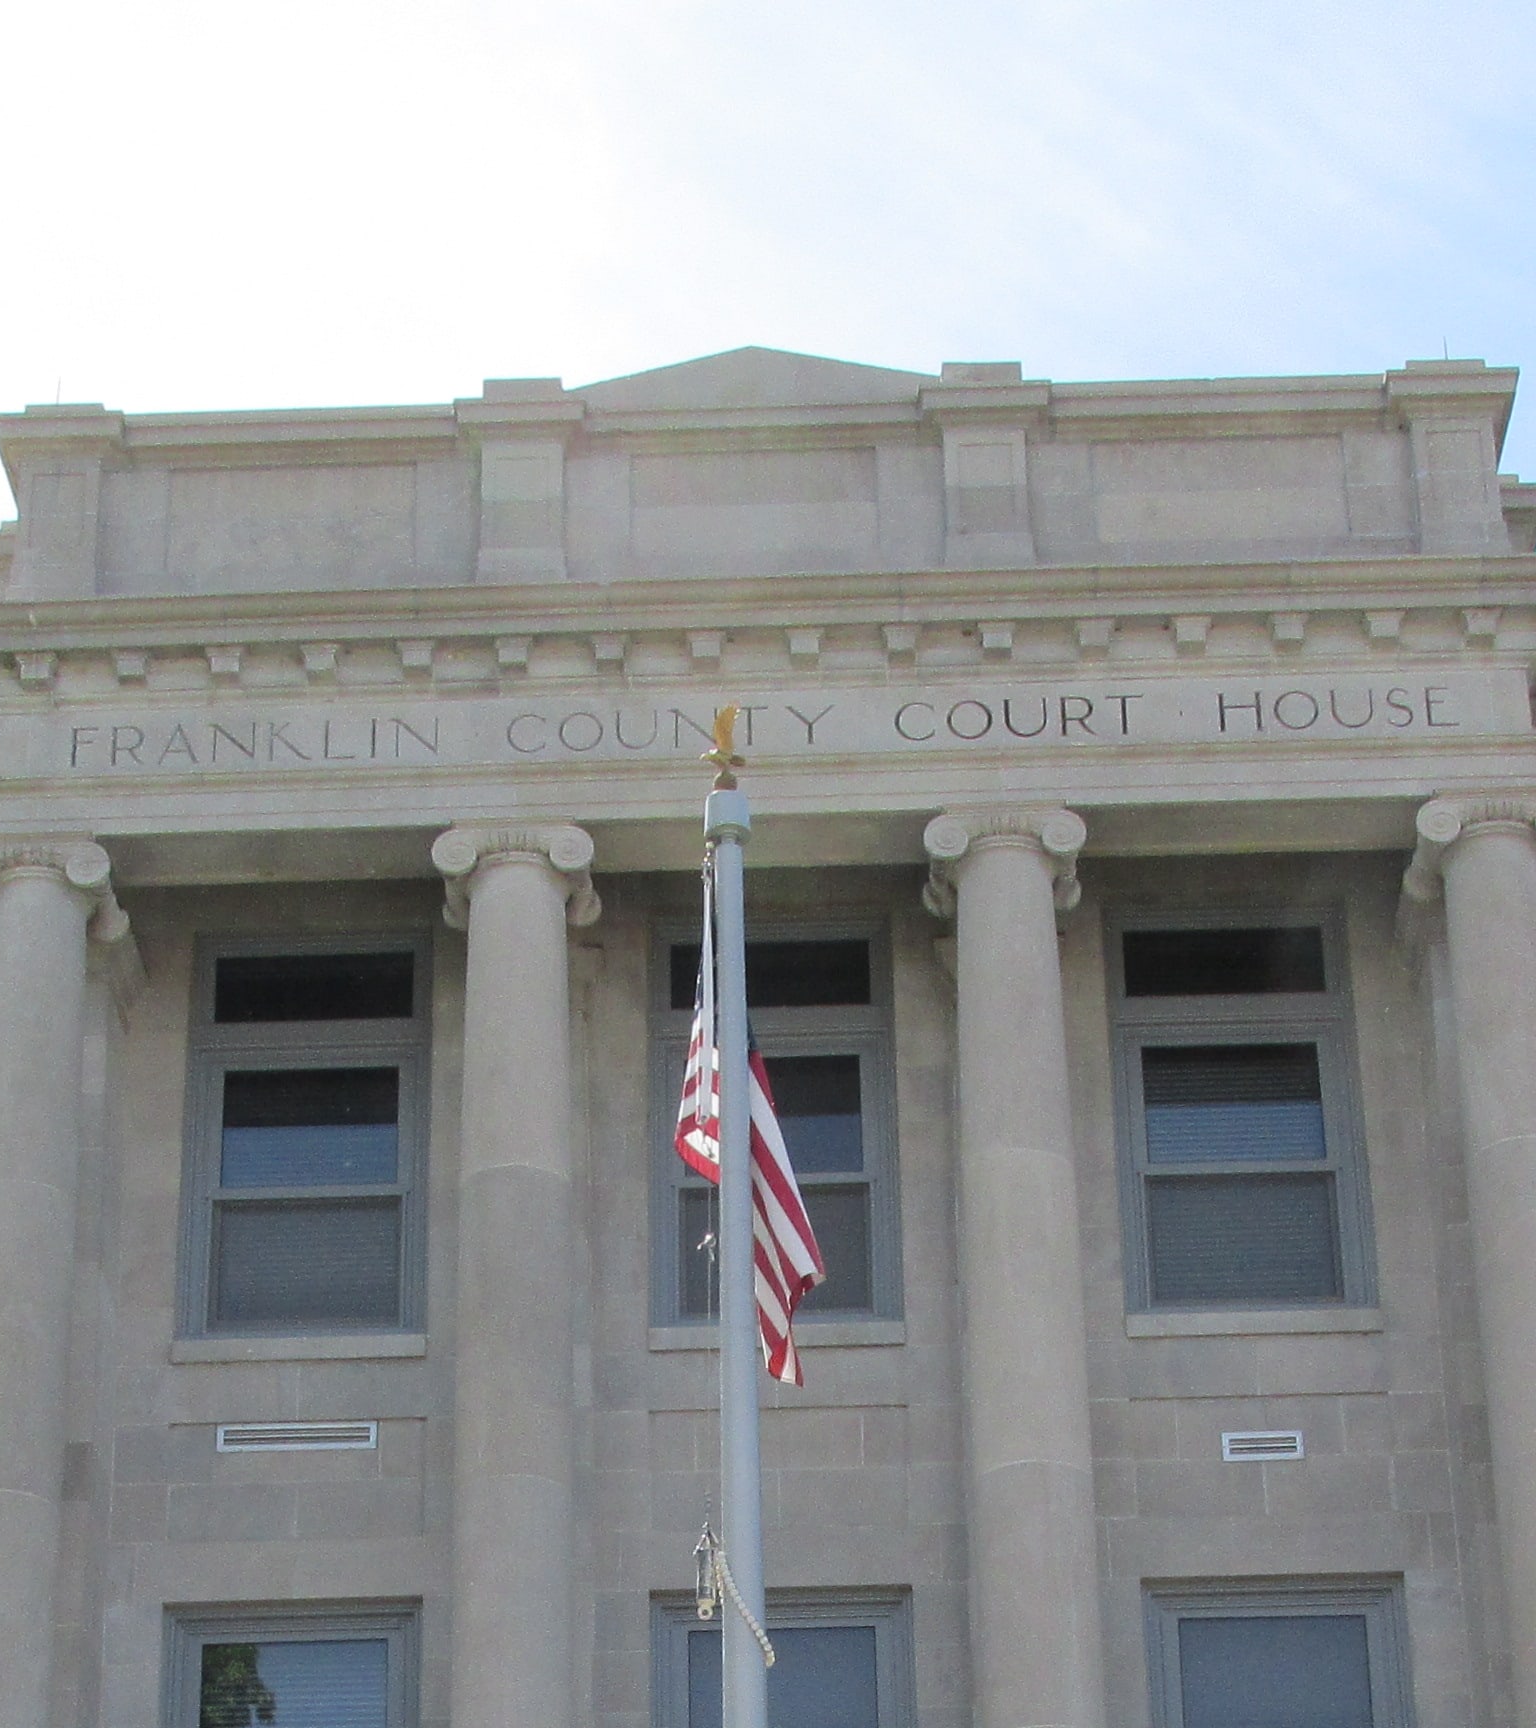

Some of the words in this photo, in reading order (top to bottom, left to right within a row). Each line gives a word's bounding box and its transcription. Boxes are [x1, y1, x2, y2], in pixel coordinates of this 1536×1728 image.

[69, 717, 440, 768] FRANKLIN
[506, 703, 836, 753] COUNTY
[894, 693, 1144, 742] COURT
[1217, 686, 1461, 733] HOUSE
